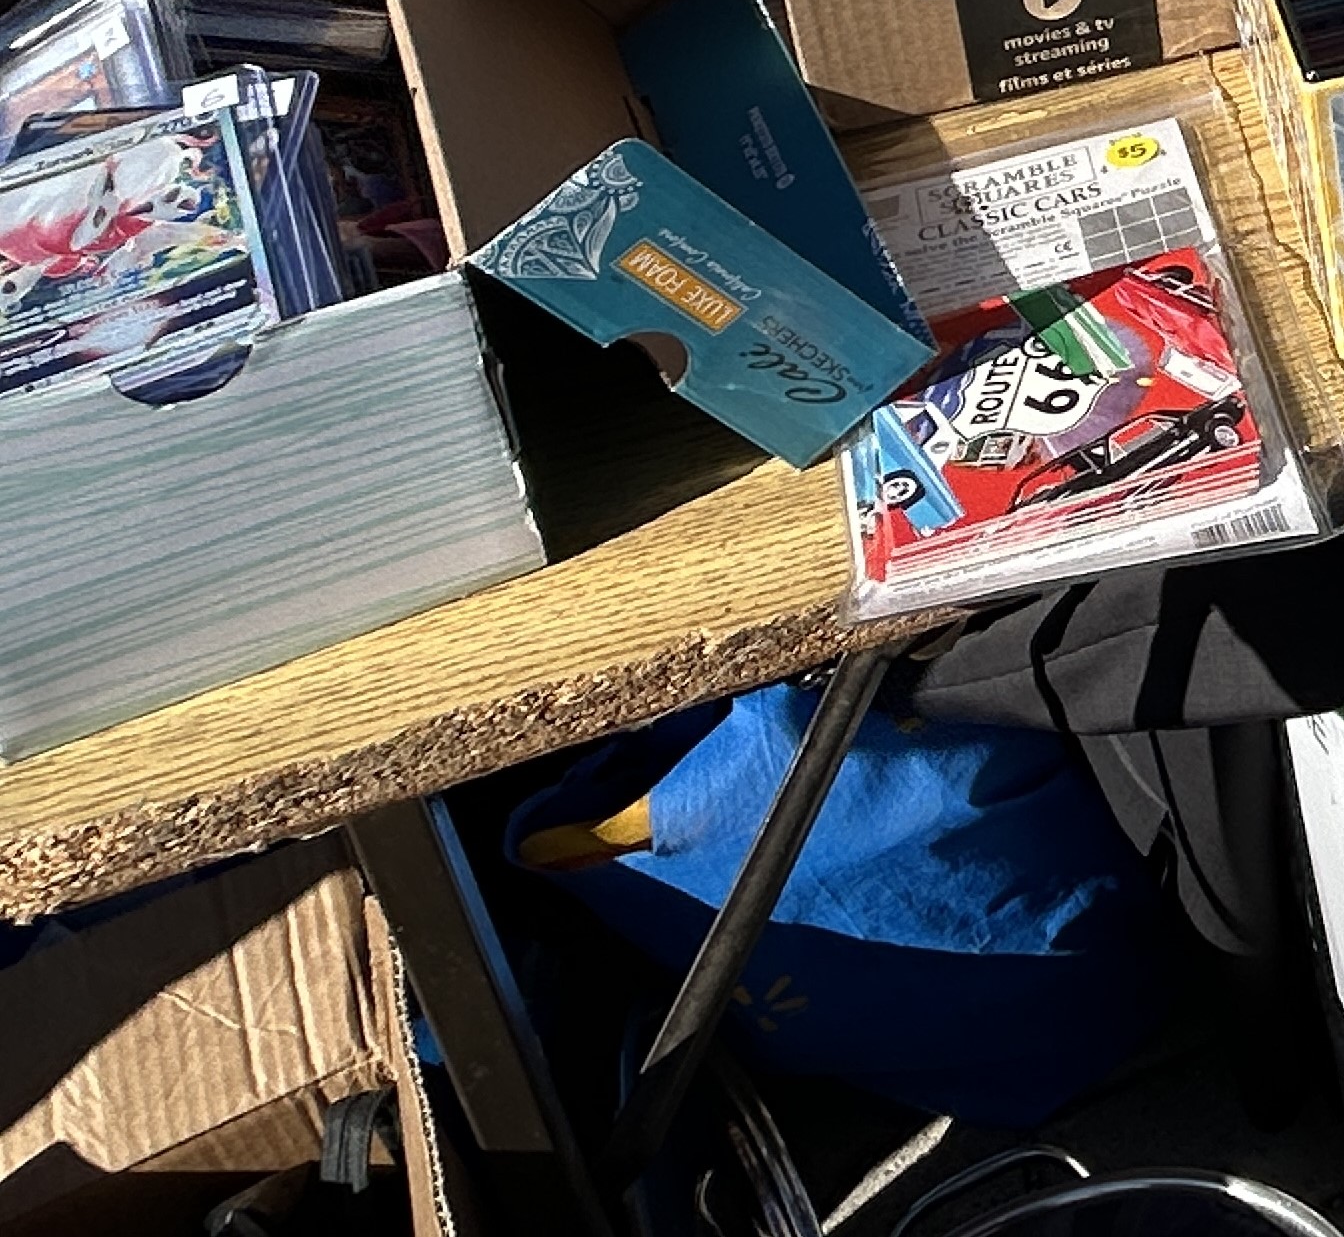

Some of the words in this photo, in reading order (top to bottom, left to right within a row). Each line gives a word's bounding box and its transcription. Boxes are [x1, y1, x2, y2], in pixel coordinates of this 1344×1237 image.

[1003, 24, 1072, 51] movies
[1074, 20, 1093, 36] &
[1095, 17, 1115, 32] tv
[1014, 36, 1111, 67] streaming
[998, 71, 1049, 94] films
[1052, 64, 1072, 83] et
[1076, 54, 1132, 75] séries
[1116, 142, 1148, 160] $5
[927, 152, 1079, 204] SCRAMBLE
[938, 169, 1076, 213] SQUARES
[917, 201, 1027, 242] CLASSIC
[1033, 180, 1103, 213] CARS
[952, 234, 978, 249] the
[1129, 175, 1183, 198] Puzzle
[628, 251, 687, 292] FOAM
[686, 284, 734, 326] LUXE
[762, 314, 851, 381] SKECHERS
[739, 341, 847, 404] Cali
[970, 355, 1020, 425] ROUTE
[1023, 361, 1081, 414] 66
